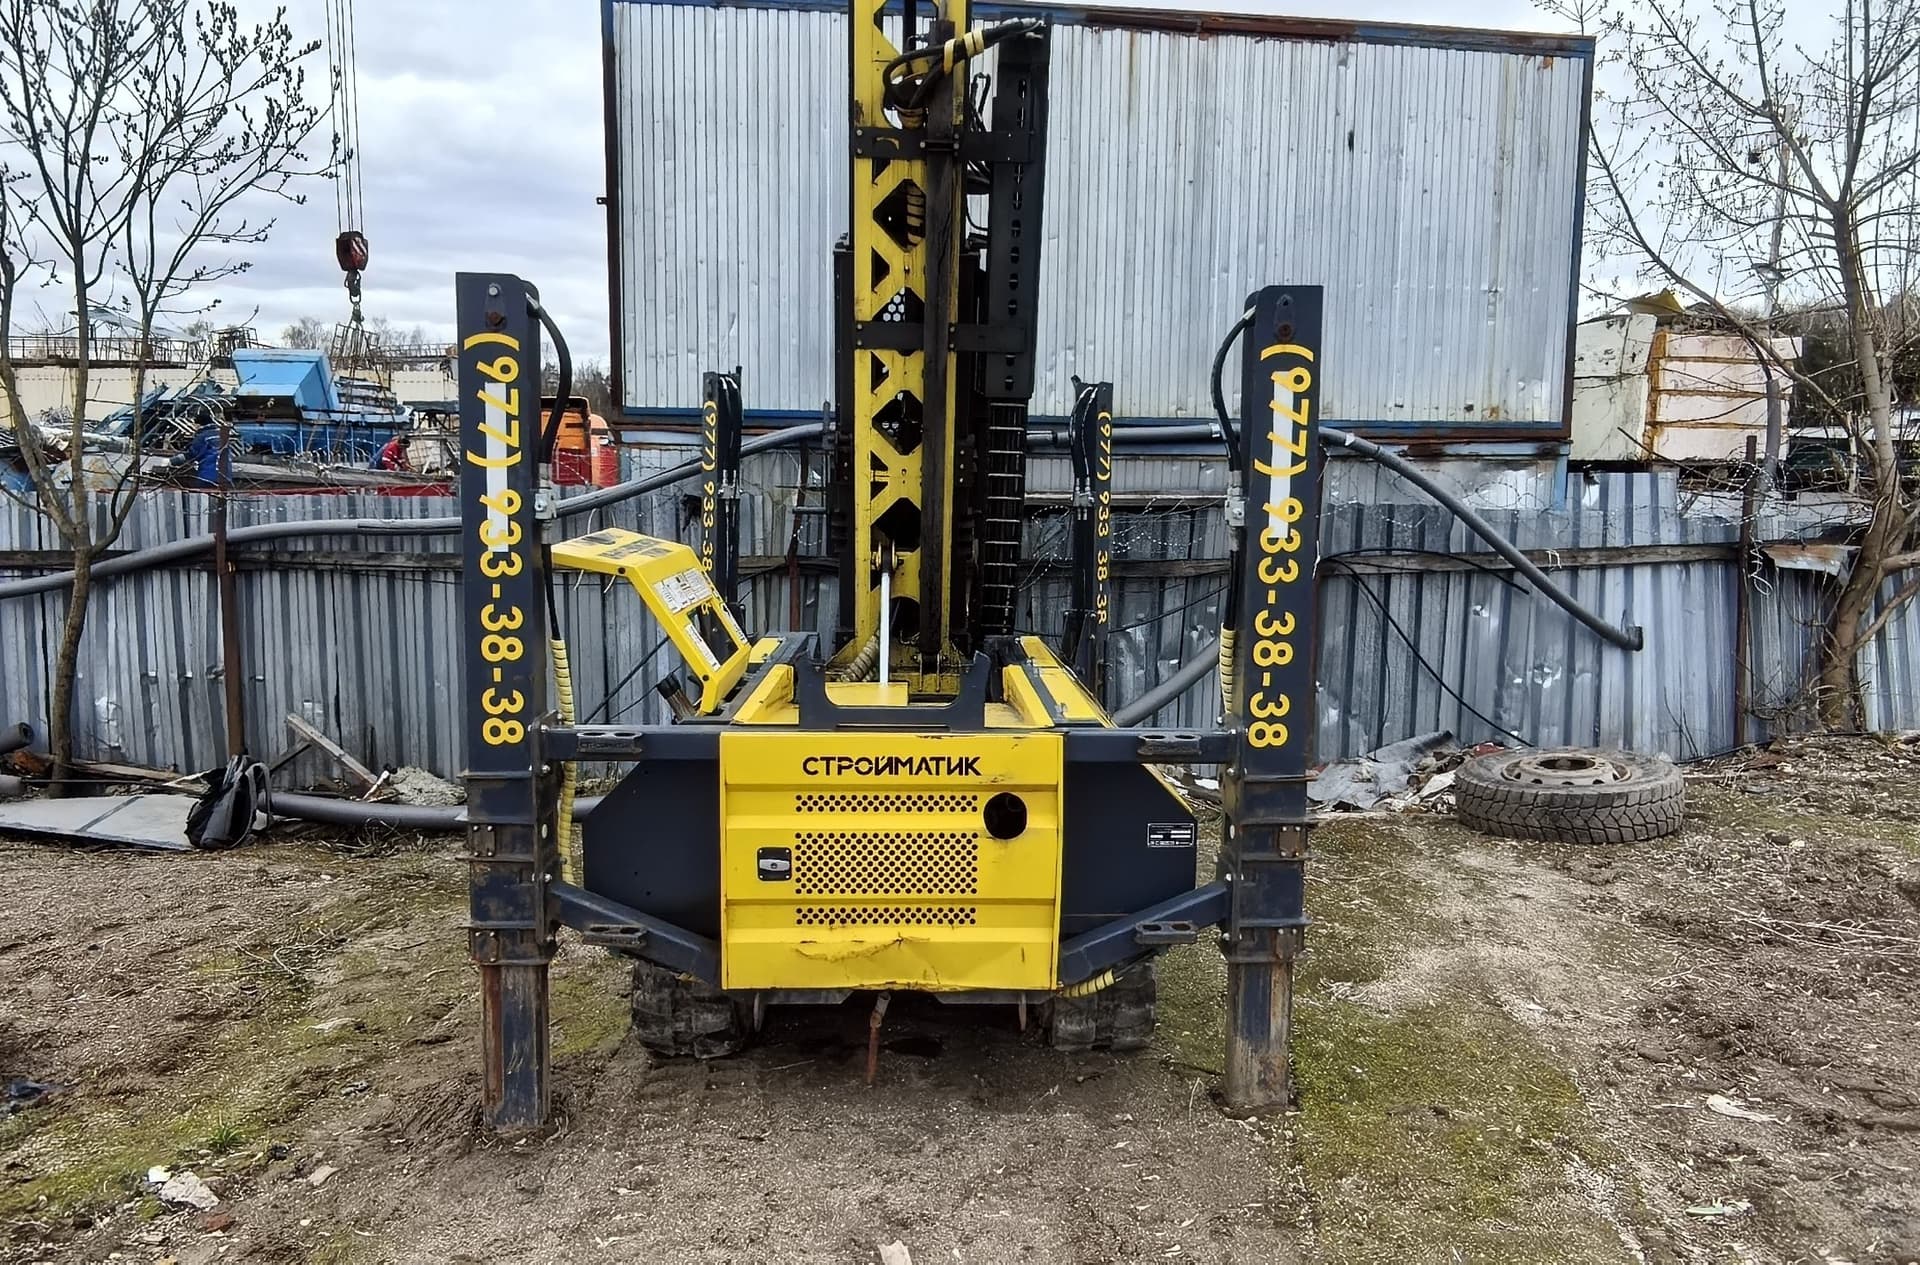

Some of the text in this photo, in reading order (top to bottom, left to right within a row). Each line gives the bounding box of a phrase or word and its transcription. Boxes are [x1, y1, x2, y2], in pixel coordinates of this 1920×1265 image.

[703, 400, 718, 472] (977)
[1097, 411, 1112, 481] (977)
[463, 332, 525, 746] (977) 933-38-38
[1247, 343, 1314, 748] (977) 933-38-38
[802, 755, 982, 776] СТРОЙМАТИК
